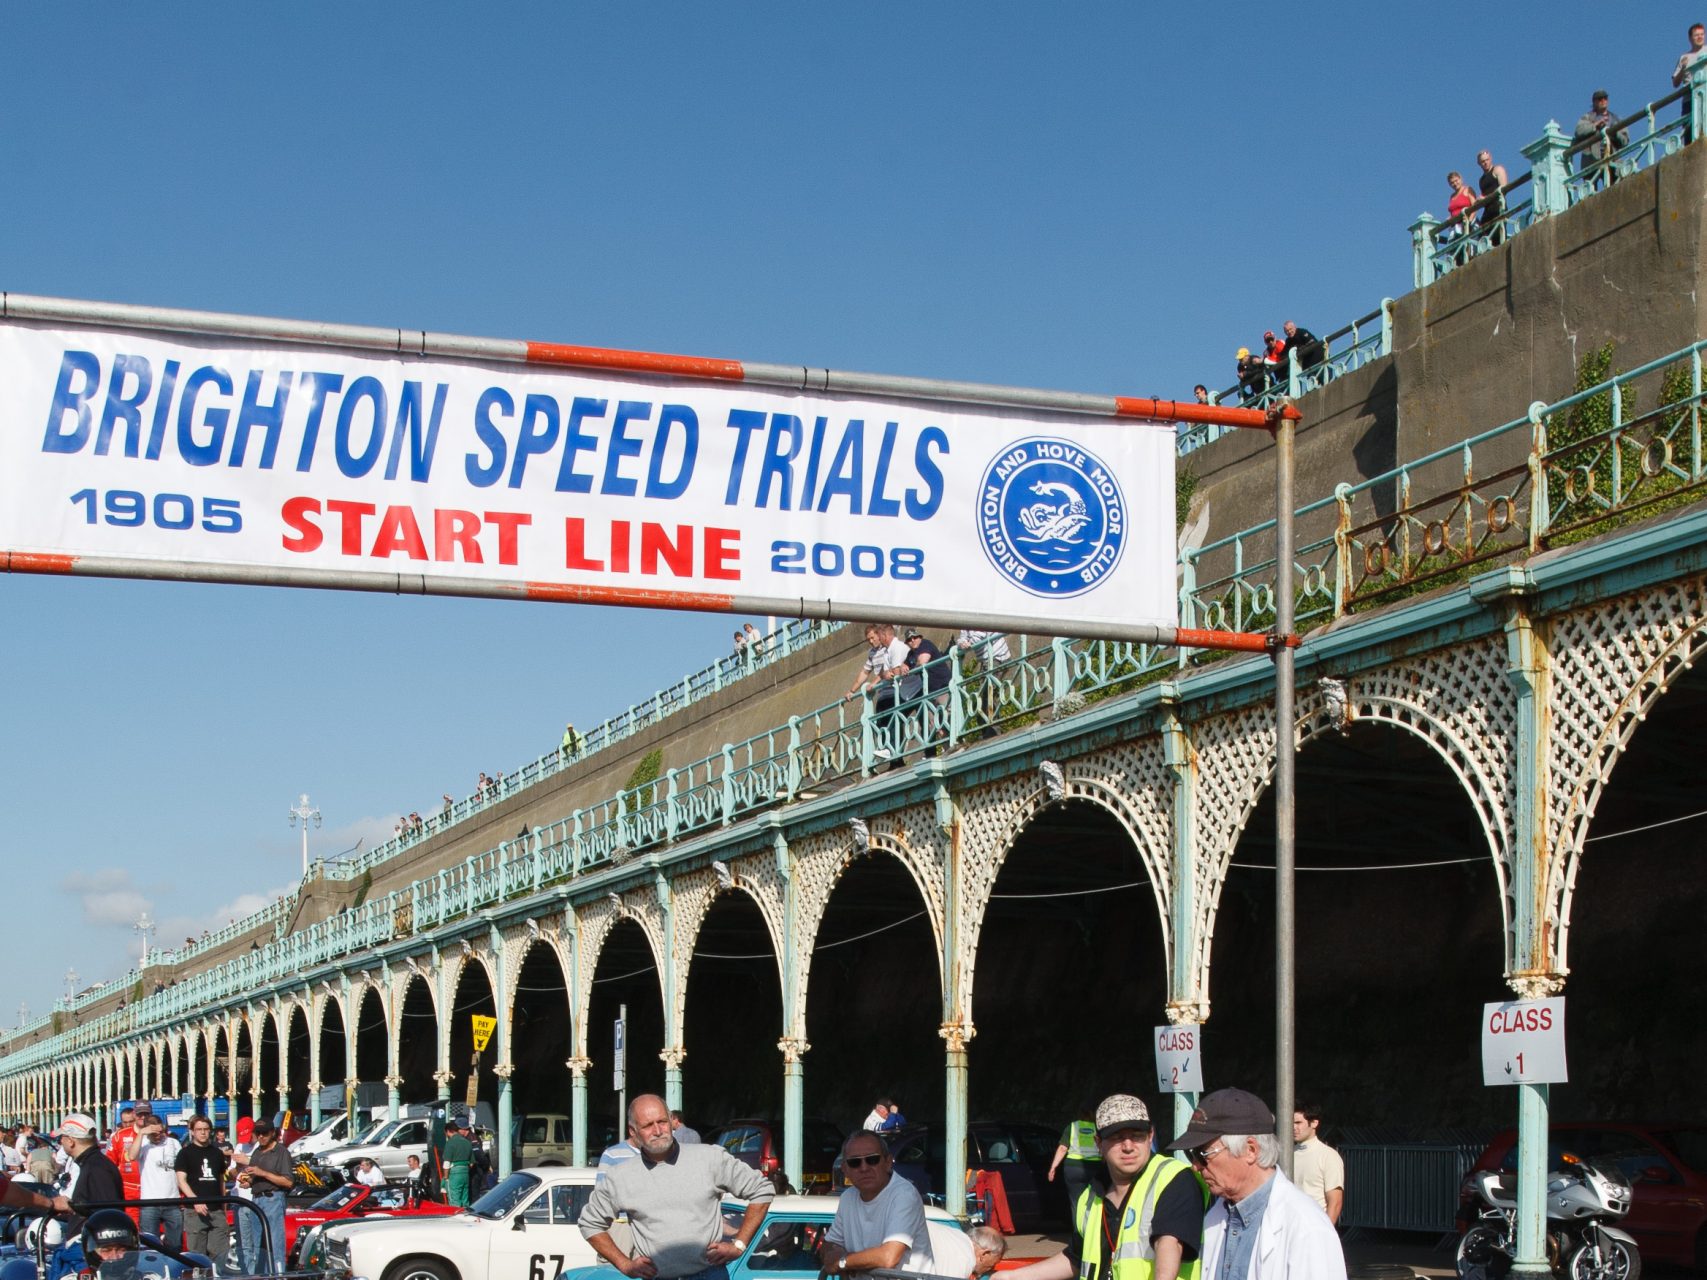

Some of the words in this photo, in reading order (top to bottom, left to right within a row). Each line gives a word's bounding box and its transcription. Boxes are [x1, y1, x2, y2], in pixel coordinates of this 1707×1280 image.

[41, 350, 449, 484] BRIGHTON
[464, 386, 699, 500] SPEED
[723, 408, 950, 521] TRIALS
[995, 449, 1028, 481] AND
[1036, 443, 1087, 468] HOVE
[70, 488, 243, 535] 1905
[1090, 468, 1121, 535] MOTOR
[281, 496, 532, 566] START
[565, 515, 741, 581] LINE
[984, 486, 1029, 581] BRIGHTON
[771, 540, 924, 581] 2008
[1080, 544, 1116, 583] CLUB
[474, 1029, 491, 1038] HERE
[477, 1020, 489, 1029] PAY
[616, 1023, 622, 1049] P
[1489, 1007, 1553, 1035] CLASS
[1159, 1032, 1194, 1052] CLASS
[1172, 1066, 1179, 1085] 2
[1516, 1052, 1524, 1075] 1
